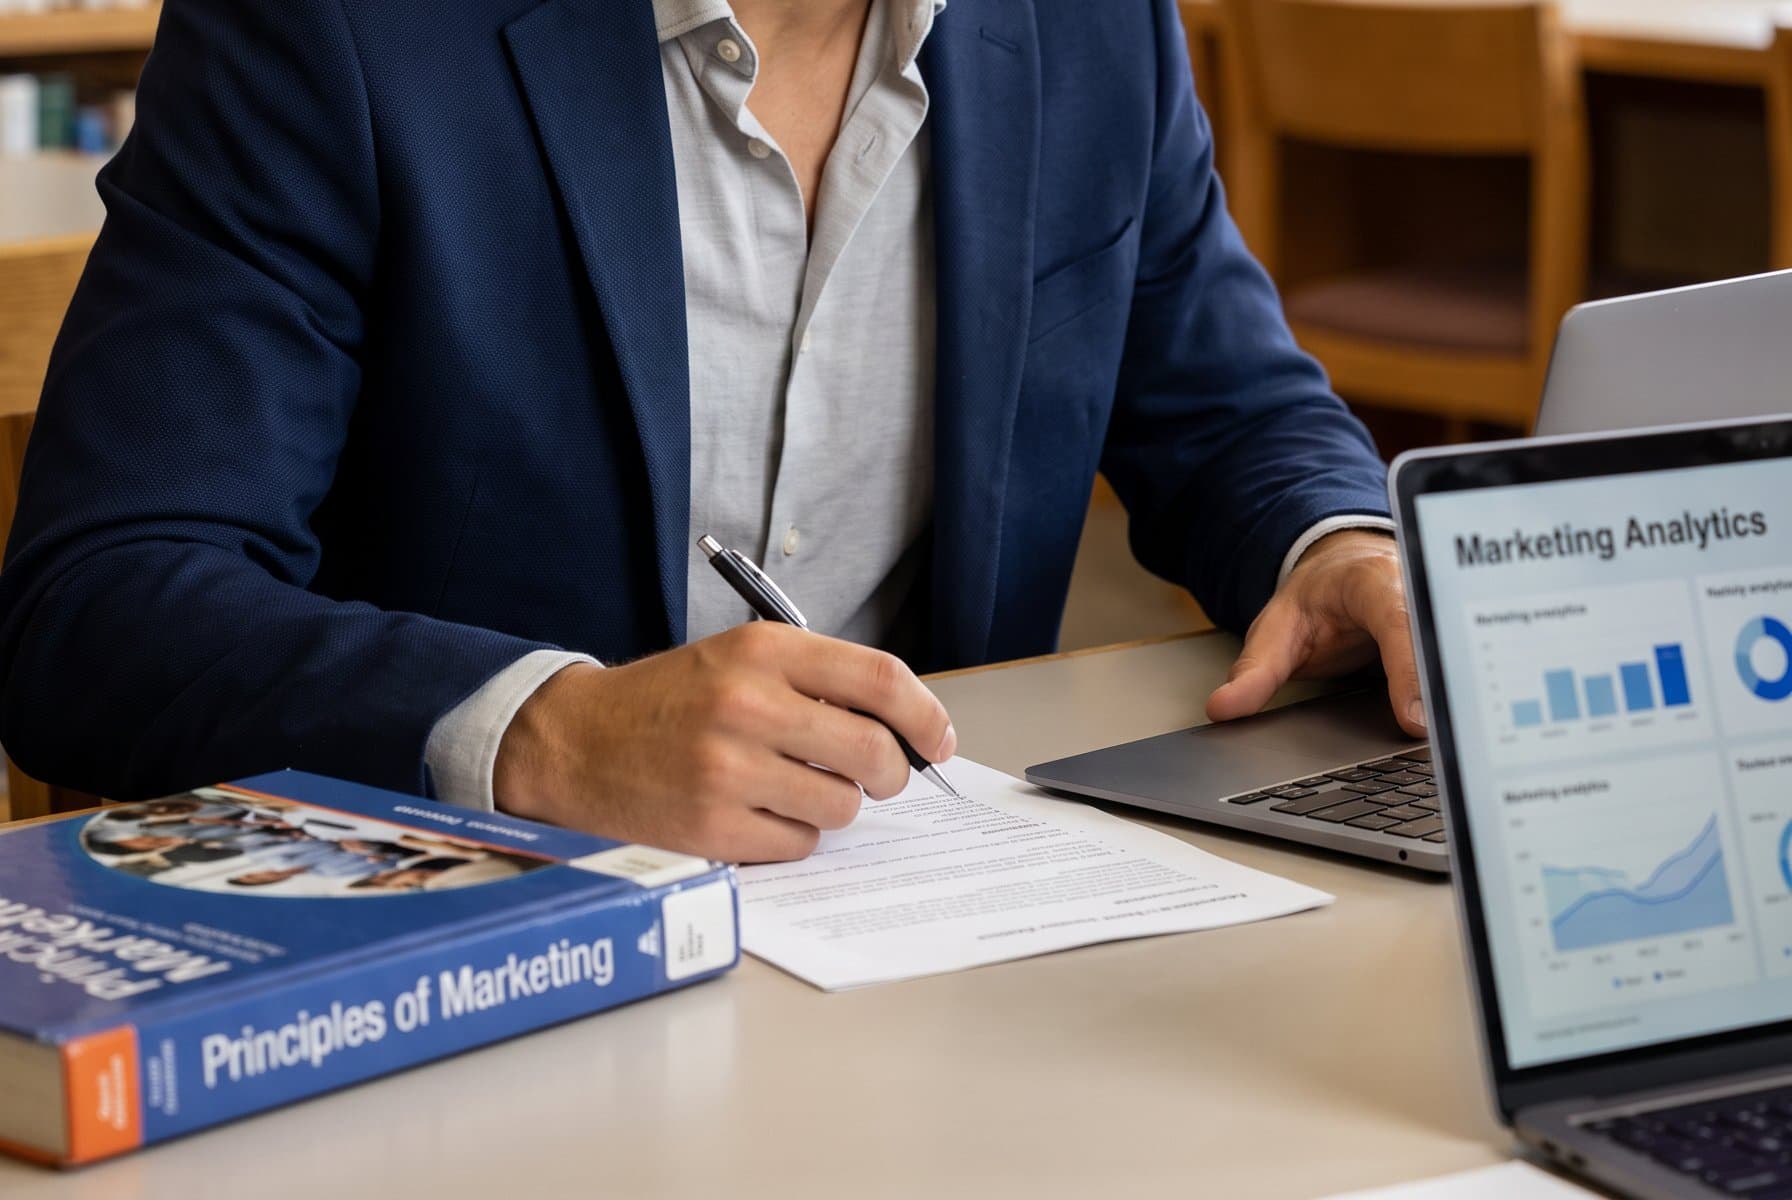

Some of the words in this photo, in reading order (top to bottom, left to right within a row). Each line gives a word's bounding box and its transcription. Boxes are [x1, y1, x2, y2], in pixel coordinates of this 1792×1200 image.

[1454, 523, 1615, 568] Marketing
[1625, 506, 1767, 551] Analytics
[202, 1000, 387, 1088] Principles
[394, 975, 432, 1033] of
[439, 937, 615, 1019] Marketing
